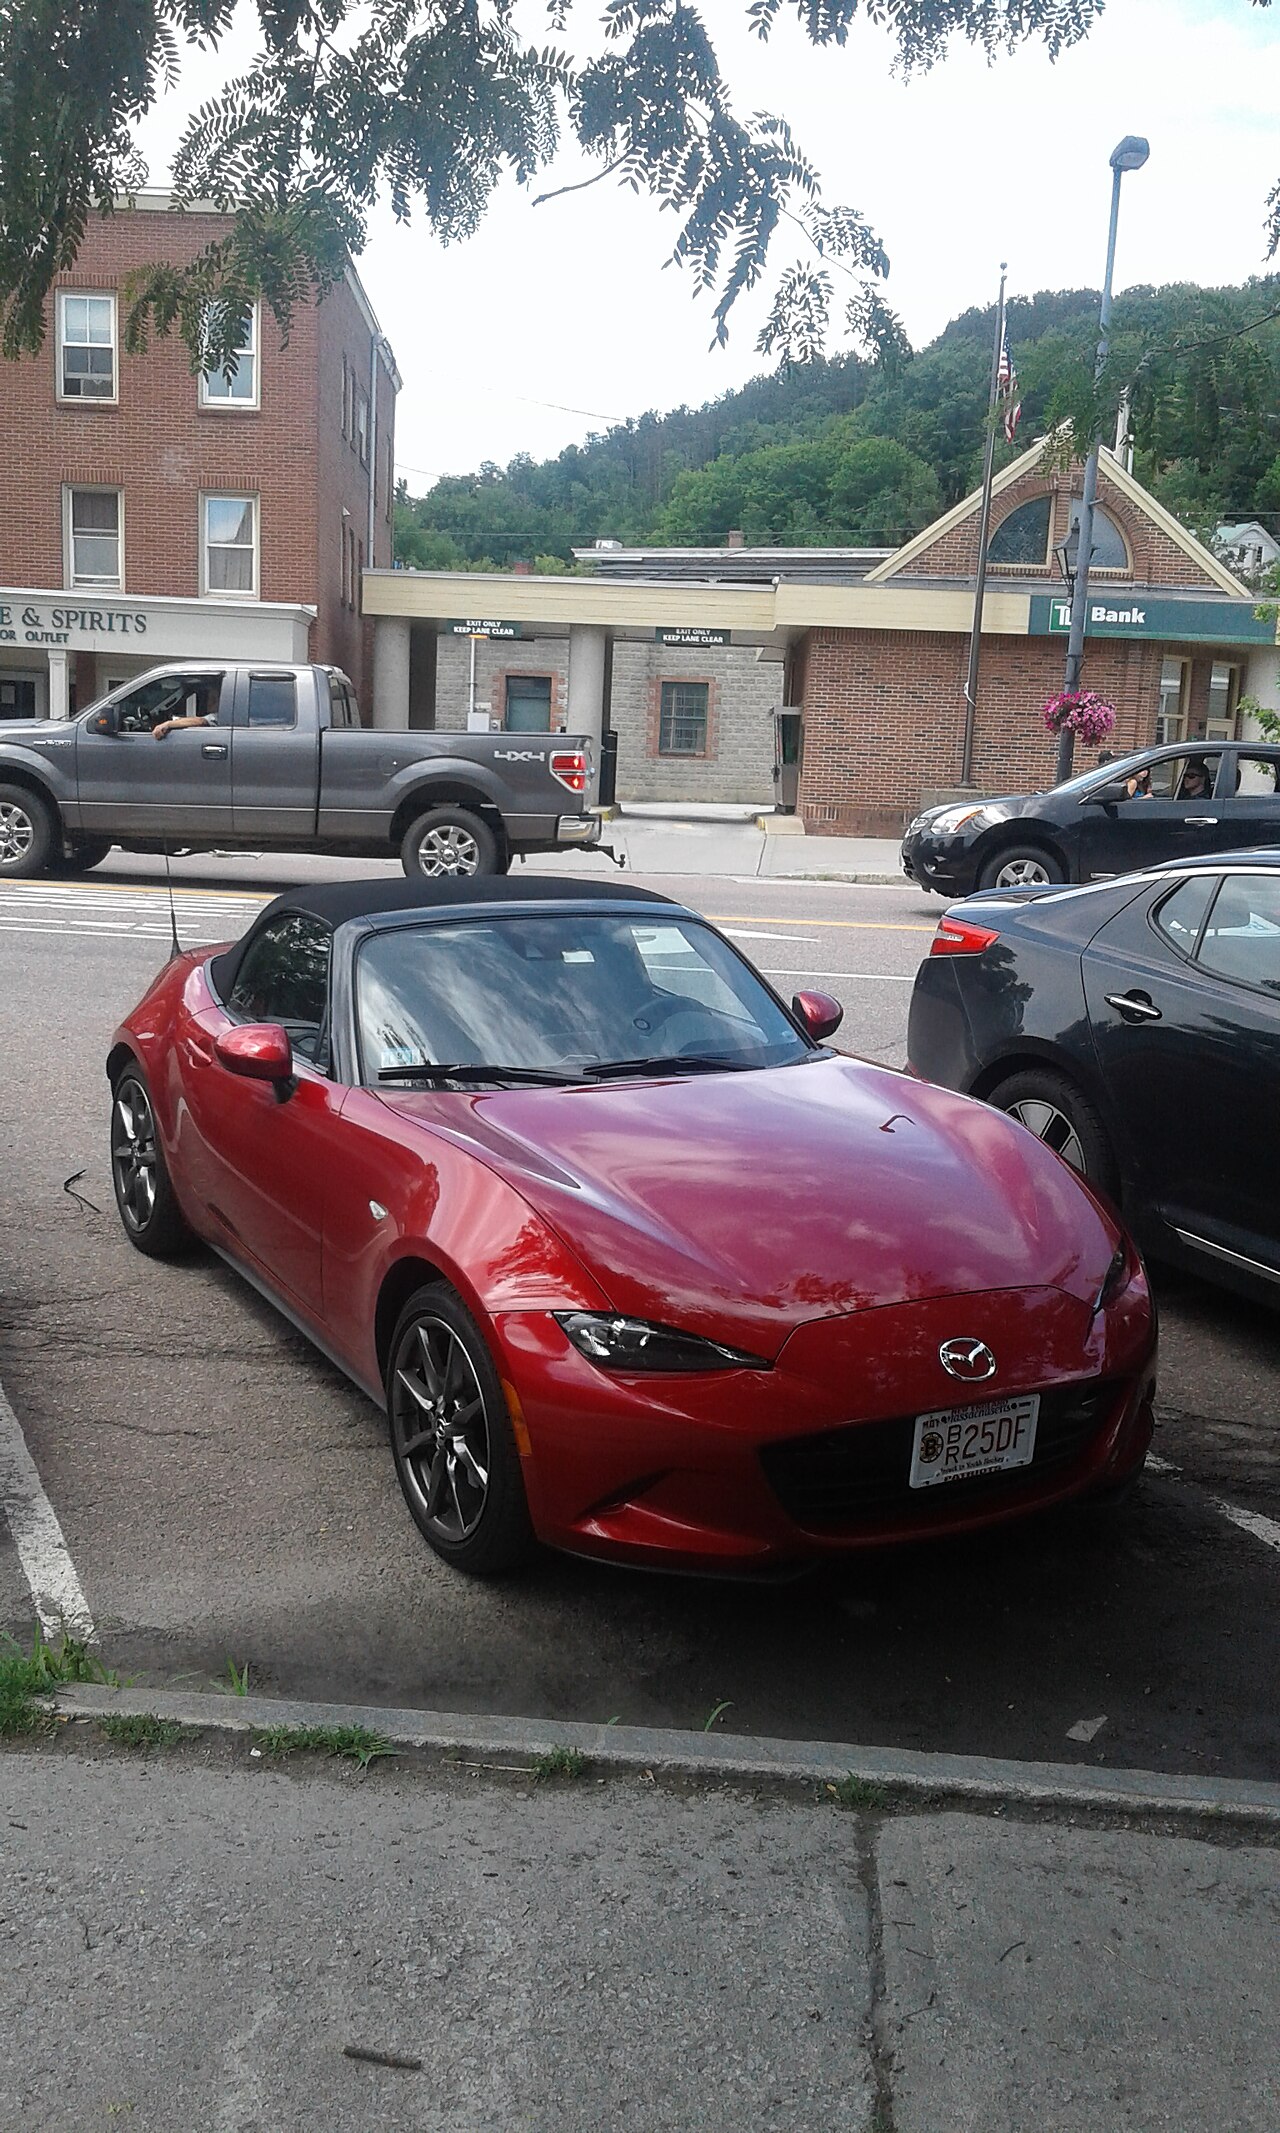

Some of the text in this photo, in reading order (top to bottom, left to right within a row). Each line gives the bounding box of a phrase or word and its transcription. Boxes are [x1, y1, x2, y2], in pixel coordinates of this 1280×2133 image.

[21, 606, 44, 627] &
[51, 608, 147, 633] SPIRITS
[1091, 606, 1146, 624] Bank
[25, 630, 69, 643] OUTLET
[491, 628, 514, 636] CLEAR
[681, 635, 700, 643] LANE
[700, 636, 724, 644] CLEAR
